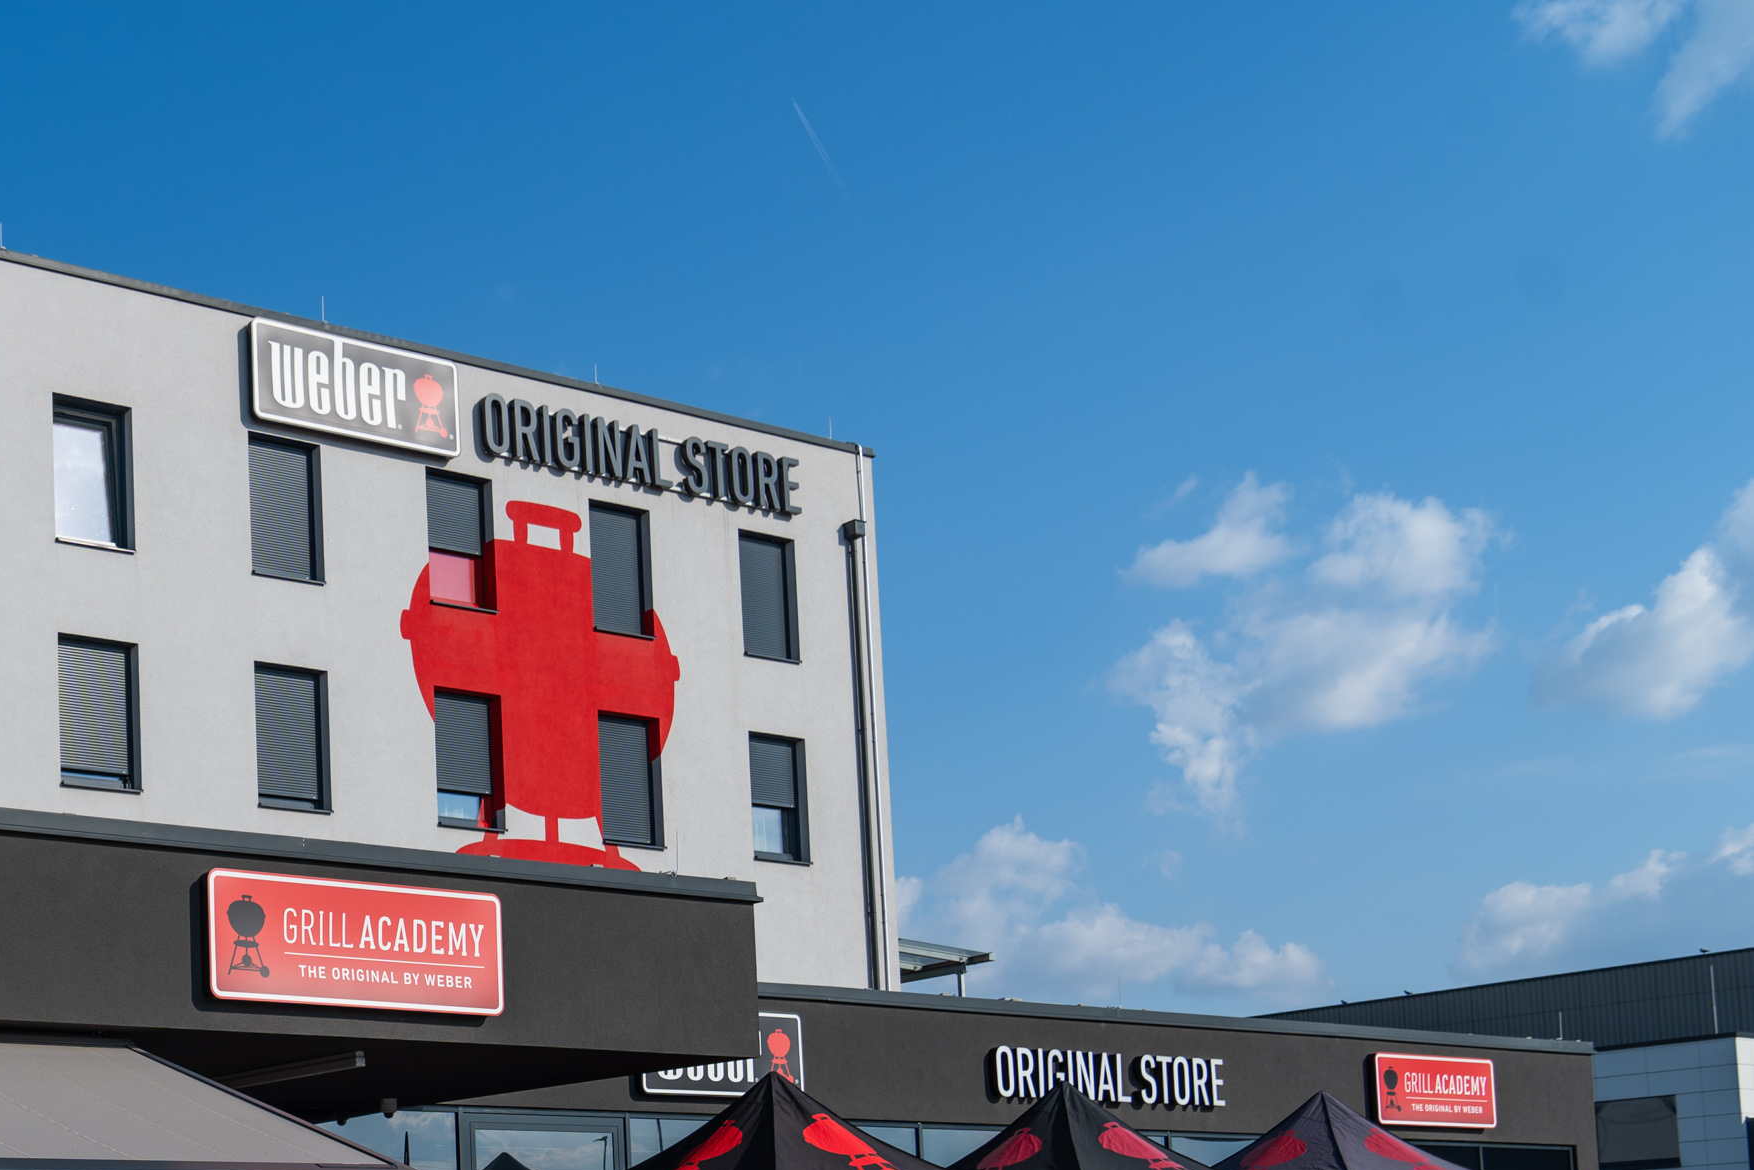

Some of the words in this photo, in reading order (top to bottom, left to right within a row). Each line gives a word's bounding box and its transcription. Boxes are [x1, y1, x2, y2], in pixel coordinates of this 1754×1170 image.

[268, 340, 406, 429] weber
[481, 393, 673, 489] ORIGINAL
[682, 437, 803, 516] STORE
[298, 964, 327, 979] THE
[331, 966, 399, 985] ORIGINAL
[403, 972, 420, 986] BY
[424, 973, 473, 989] WEBER
[995, 1045, 1132, 1103] ORIGINAL
[1140, 1054, 1226, 1107] STORE
[1411, 1103, 1424, 1111] THE
[1424, 1104, 1453, 1113] ORIGINAL
[1453, 1106, 1462, 1114] BY
[1462, 1106, 1484, 1114] WEBER
